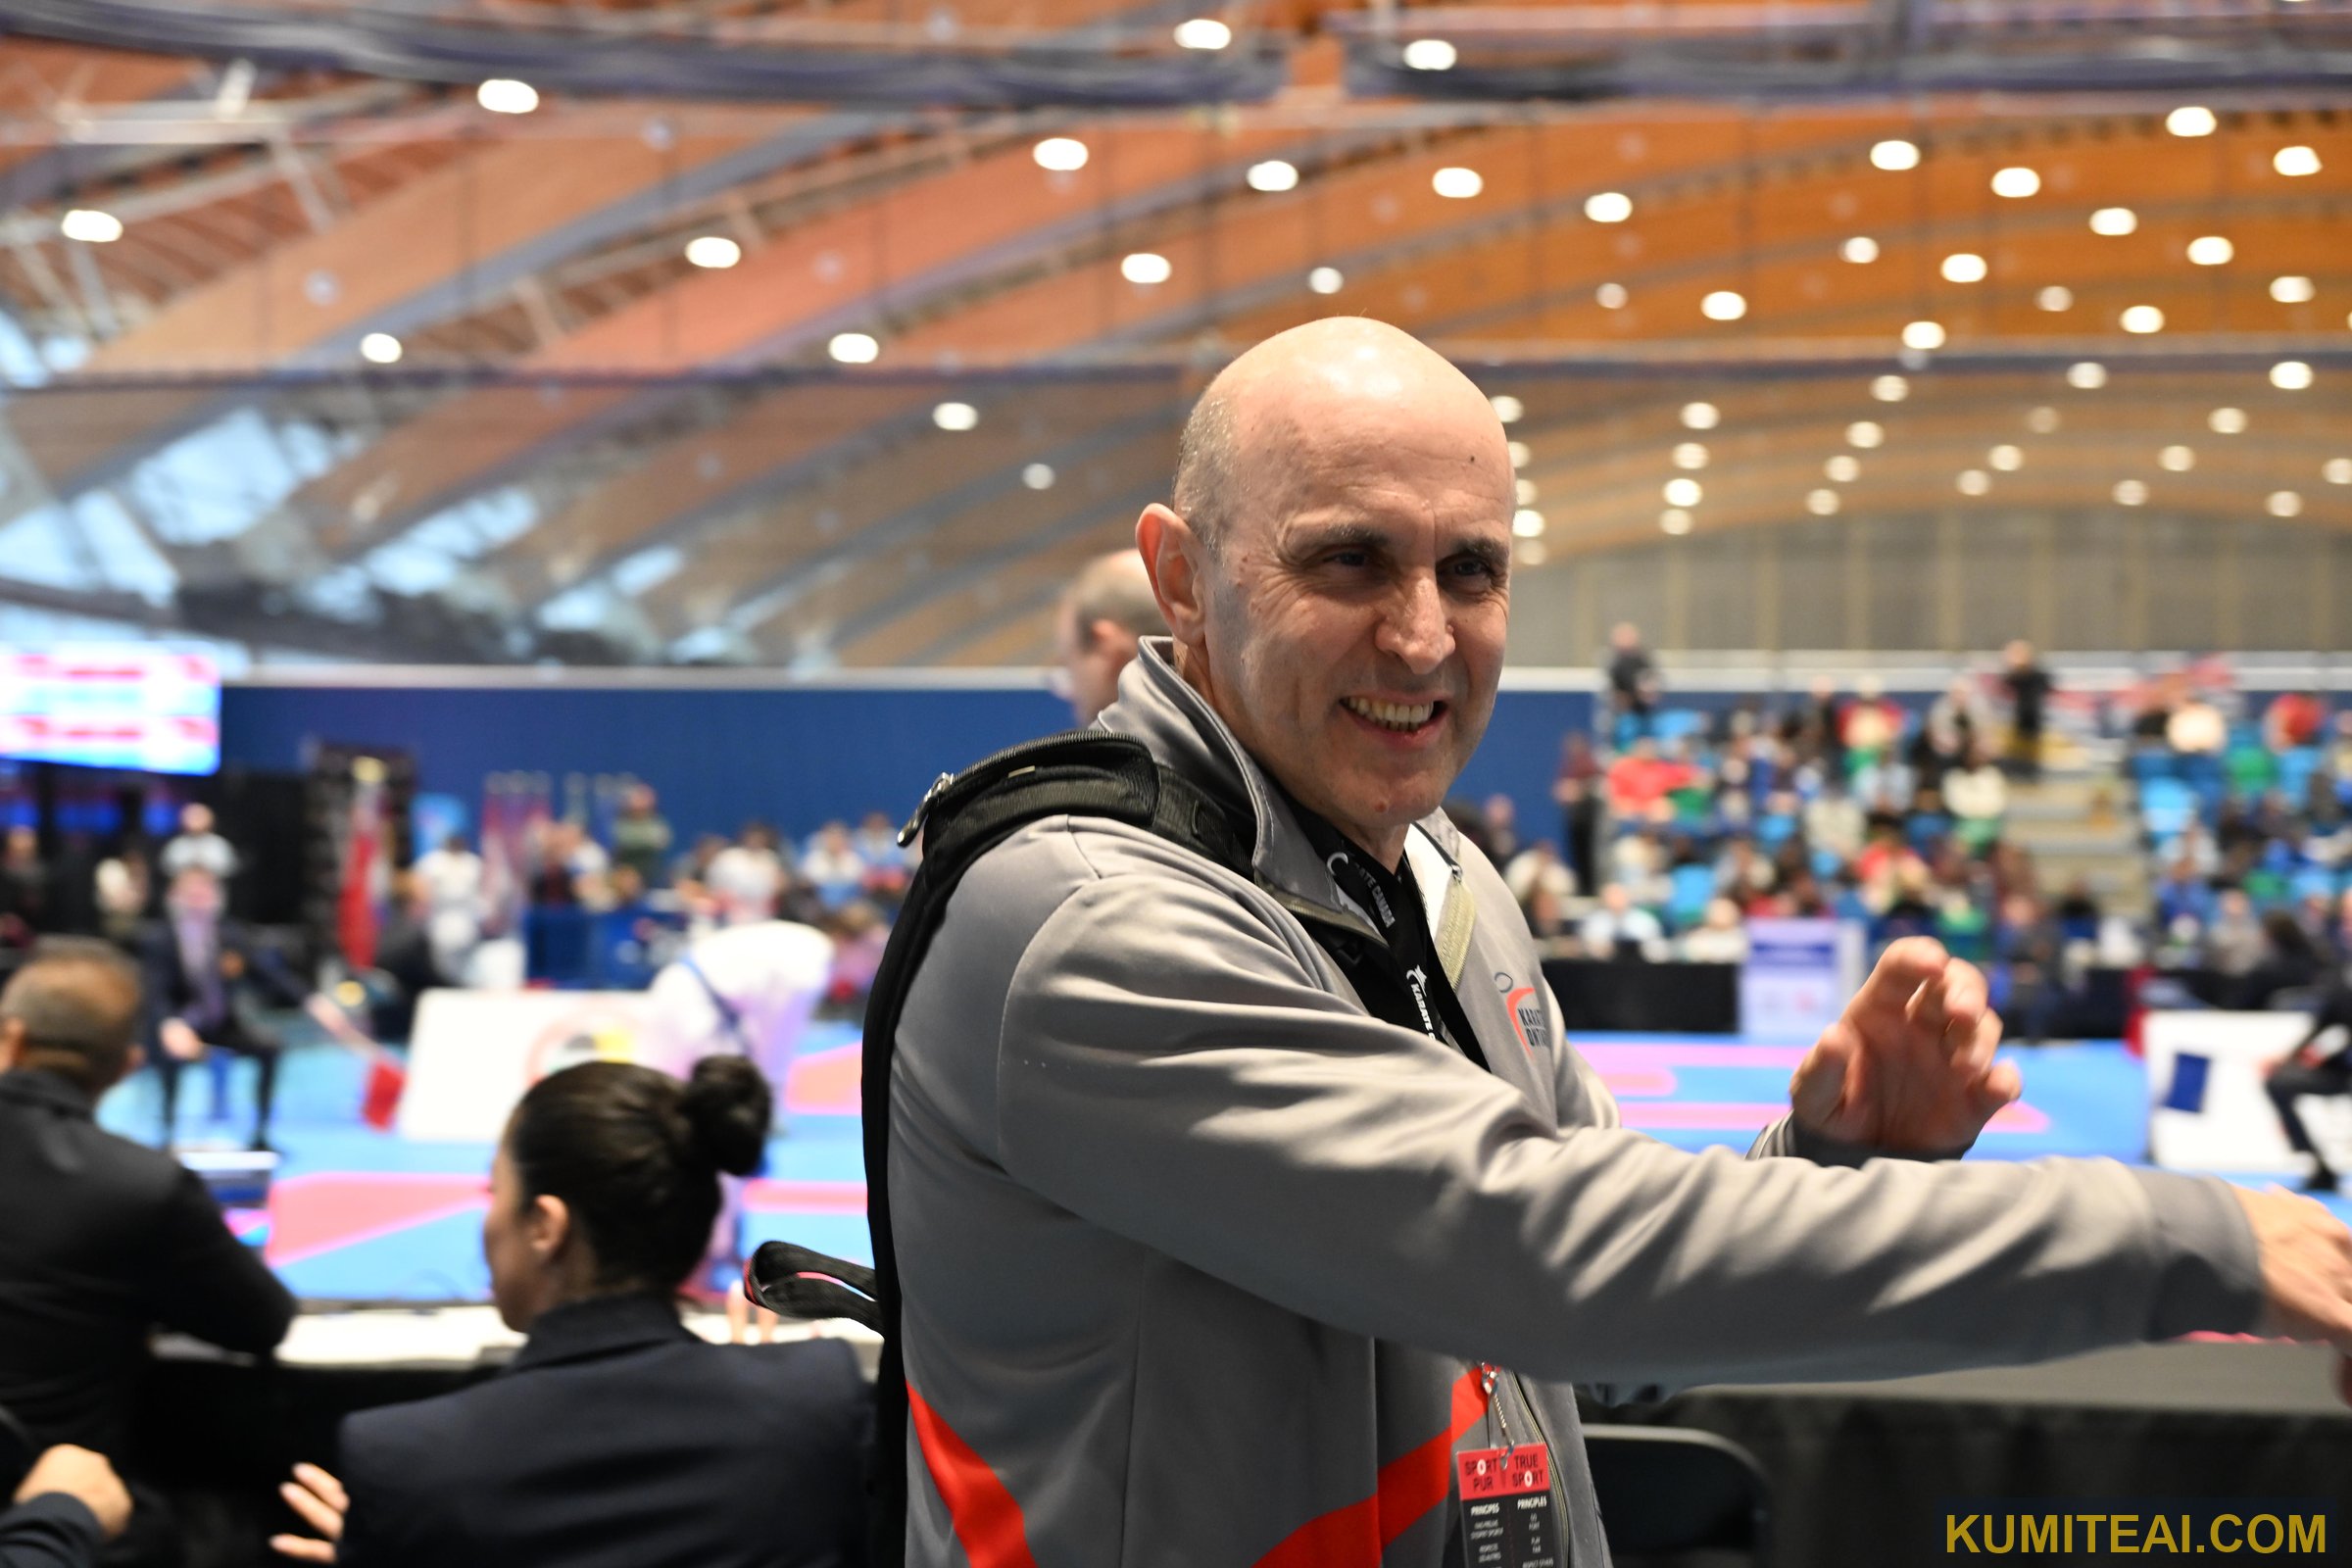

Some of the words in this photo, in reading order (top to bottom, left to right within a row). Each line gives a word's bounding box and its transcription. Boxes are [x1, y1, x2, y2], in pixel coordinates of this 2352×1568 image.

[1411, 983, 1433, 1031] KARATE
[1465, 1457, 1497, 1476] SPORT
[1514, 1453, 1539, 1469] TRUE
[1473, 1476, 1494, 1492] PUR
[1512, 1469, 1544, 1488] SPORT
